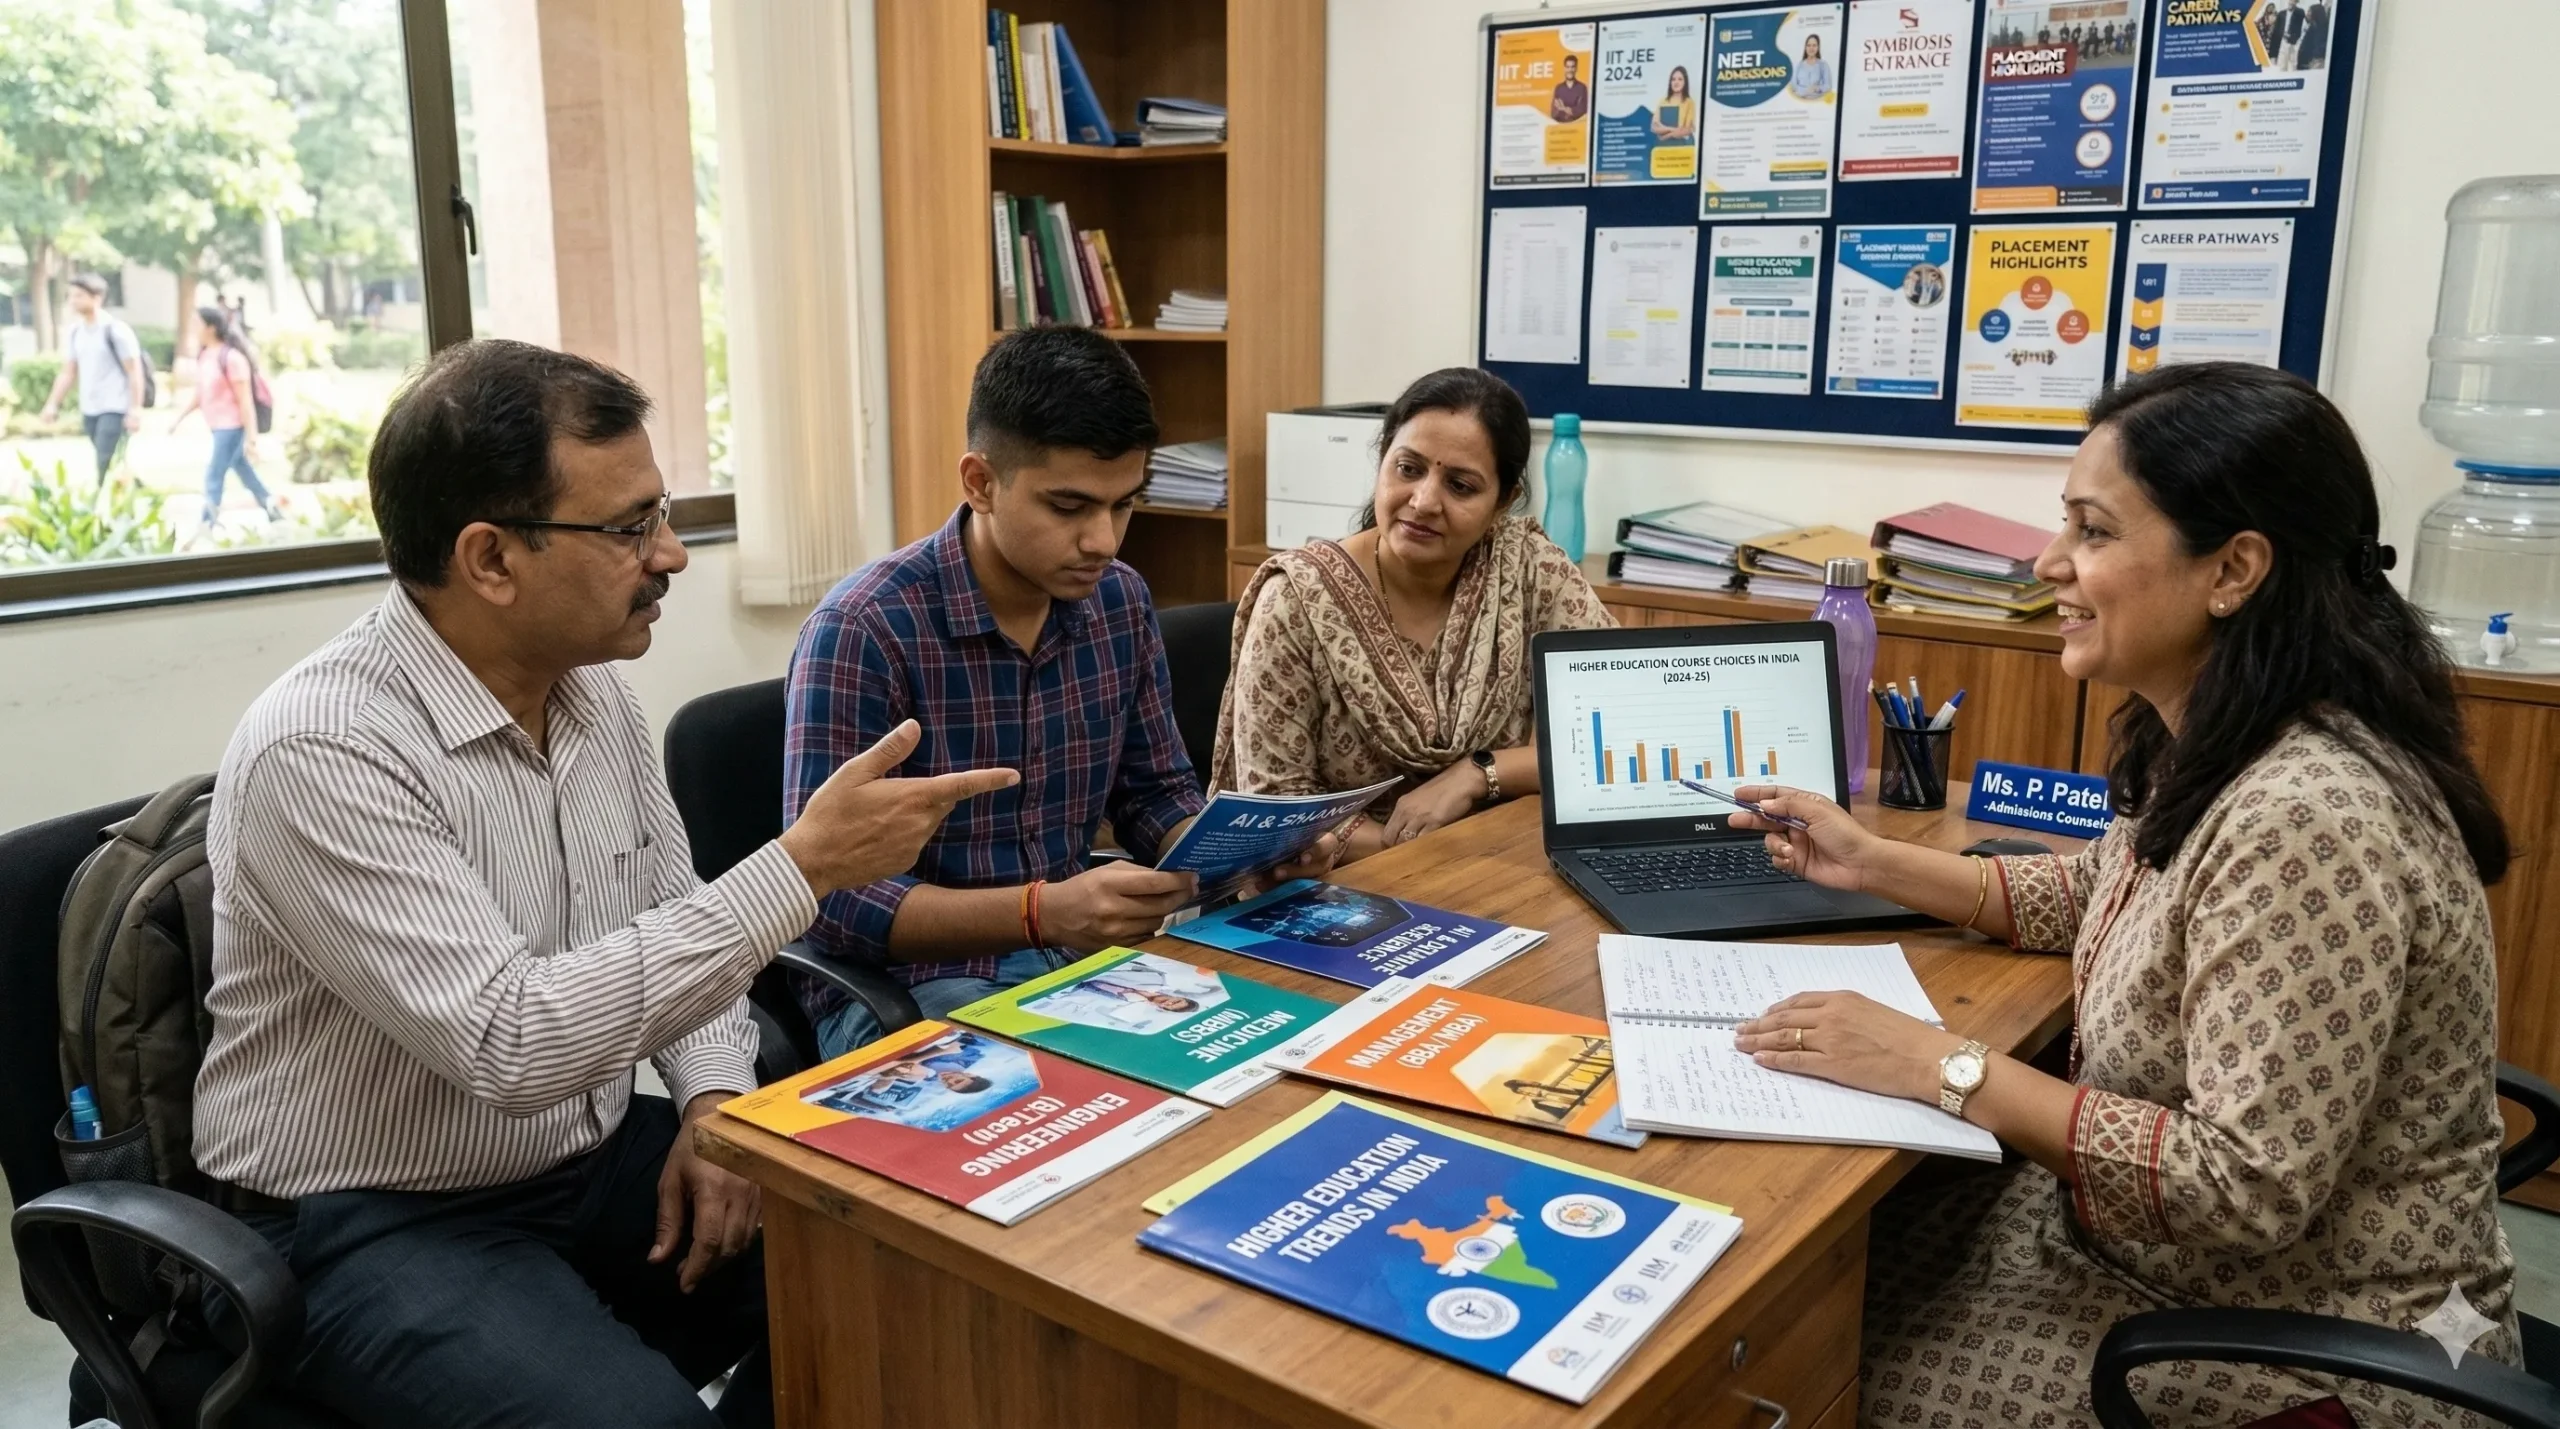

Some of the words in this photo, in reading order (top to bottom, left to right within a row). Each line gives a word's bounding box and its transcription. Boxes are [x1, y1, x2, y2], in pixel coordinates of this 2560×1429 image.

[2166, 10, 2241, 26] PATHWAYS
[1863, 33, 1952, 54] SYMBIOSIS
[1606, 50, 1624, 65] IIT
[1627, 48, 1655, 63] JEE
[1717, 50, 1765, 69] NEET
[1864, 52, 1951, 72] ENTRANCE
[1500, 64, 1520, 80] IIT
[1524, 61, 1554, 79] JEE
[1604, 65, 1642, 81] 2024
[1991, 240, 2090, 253] PLACEMENT
[2141, 233, 2194, 244] CAREER
[2198, 232, 2279, 244] PATHWAYS
[1990, 256, 2088, 269] HIGHLIGHTS
[1569, 661, 1608, 672] HIGHER
[1610, 658, 1669, 670] EDUCATION
[1671, 657, 1711, 668] COURSE
[1714, 655, 1756, 666] CHOICES
[1758, 655, 1768, 664] IN
[1771, 653, 1800, 663] INDIA
[1663, 671, 1710, 685] (2024-25)
[1982, 771, 2019, 797] Ms.
[2026, 778, 2044, 801] P.
[2051, 781, 2108, 811] Patel
[1228, 813, 1259, 828] AI
[1257, 815, 1276, 828] &
[2056, 811, 2112, 831] Counselo
[1169, 1007, 1251, 1044] (MBBS)
[1345, 997, 1461, 1068] MANAGEMENT
[1186, 1010, 1297, 1063] MEDICINE
[960, 1092, 1130, 1177] ENGINEERING
[1226, 1200, 1322, 1259] HIGHER
[1302, 1133, 1420, 1207] EDUCATION
[1277, 1204, 1376, 1264] TRENDS
[1356, 1187, 1399, 1211] IN
[1379, 1153, 1449, 1193] INDIA
[1638, 1257, 1670, 1280] IIM
[1582, 1311, 1614, 1334] IIM
